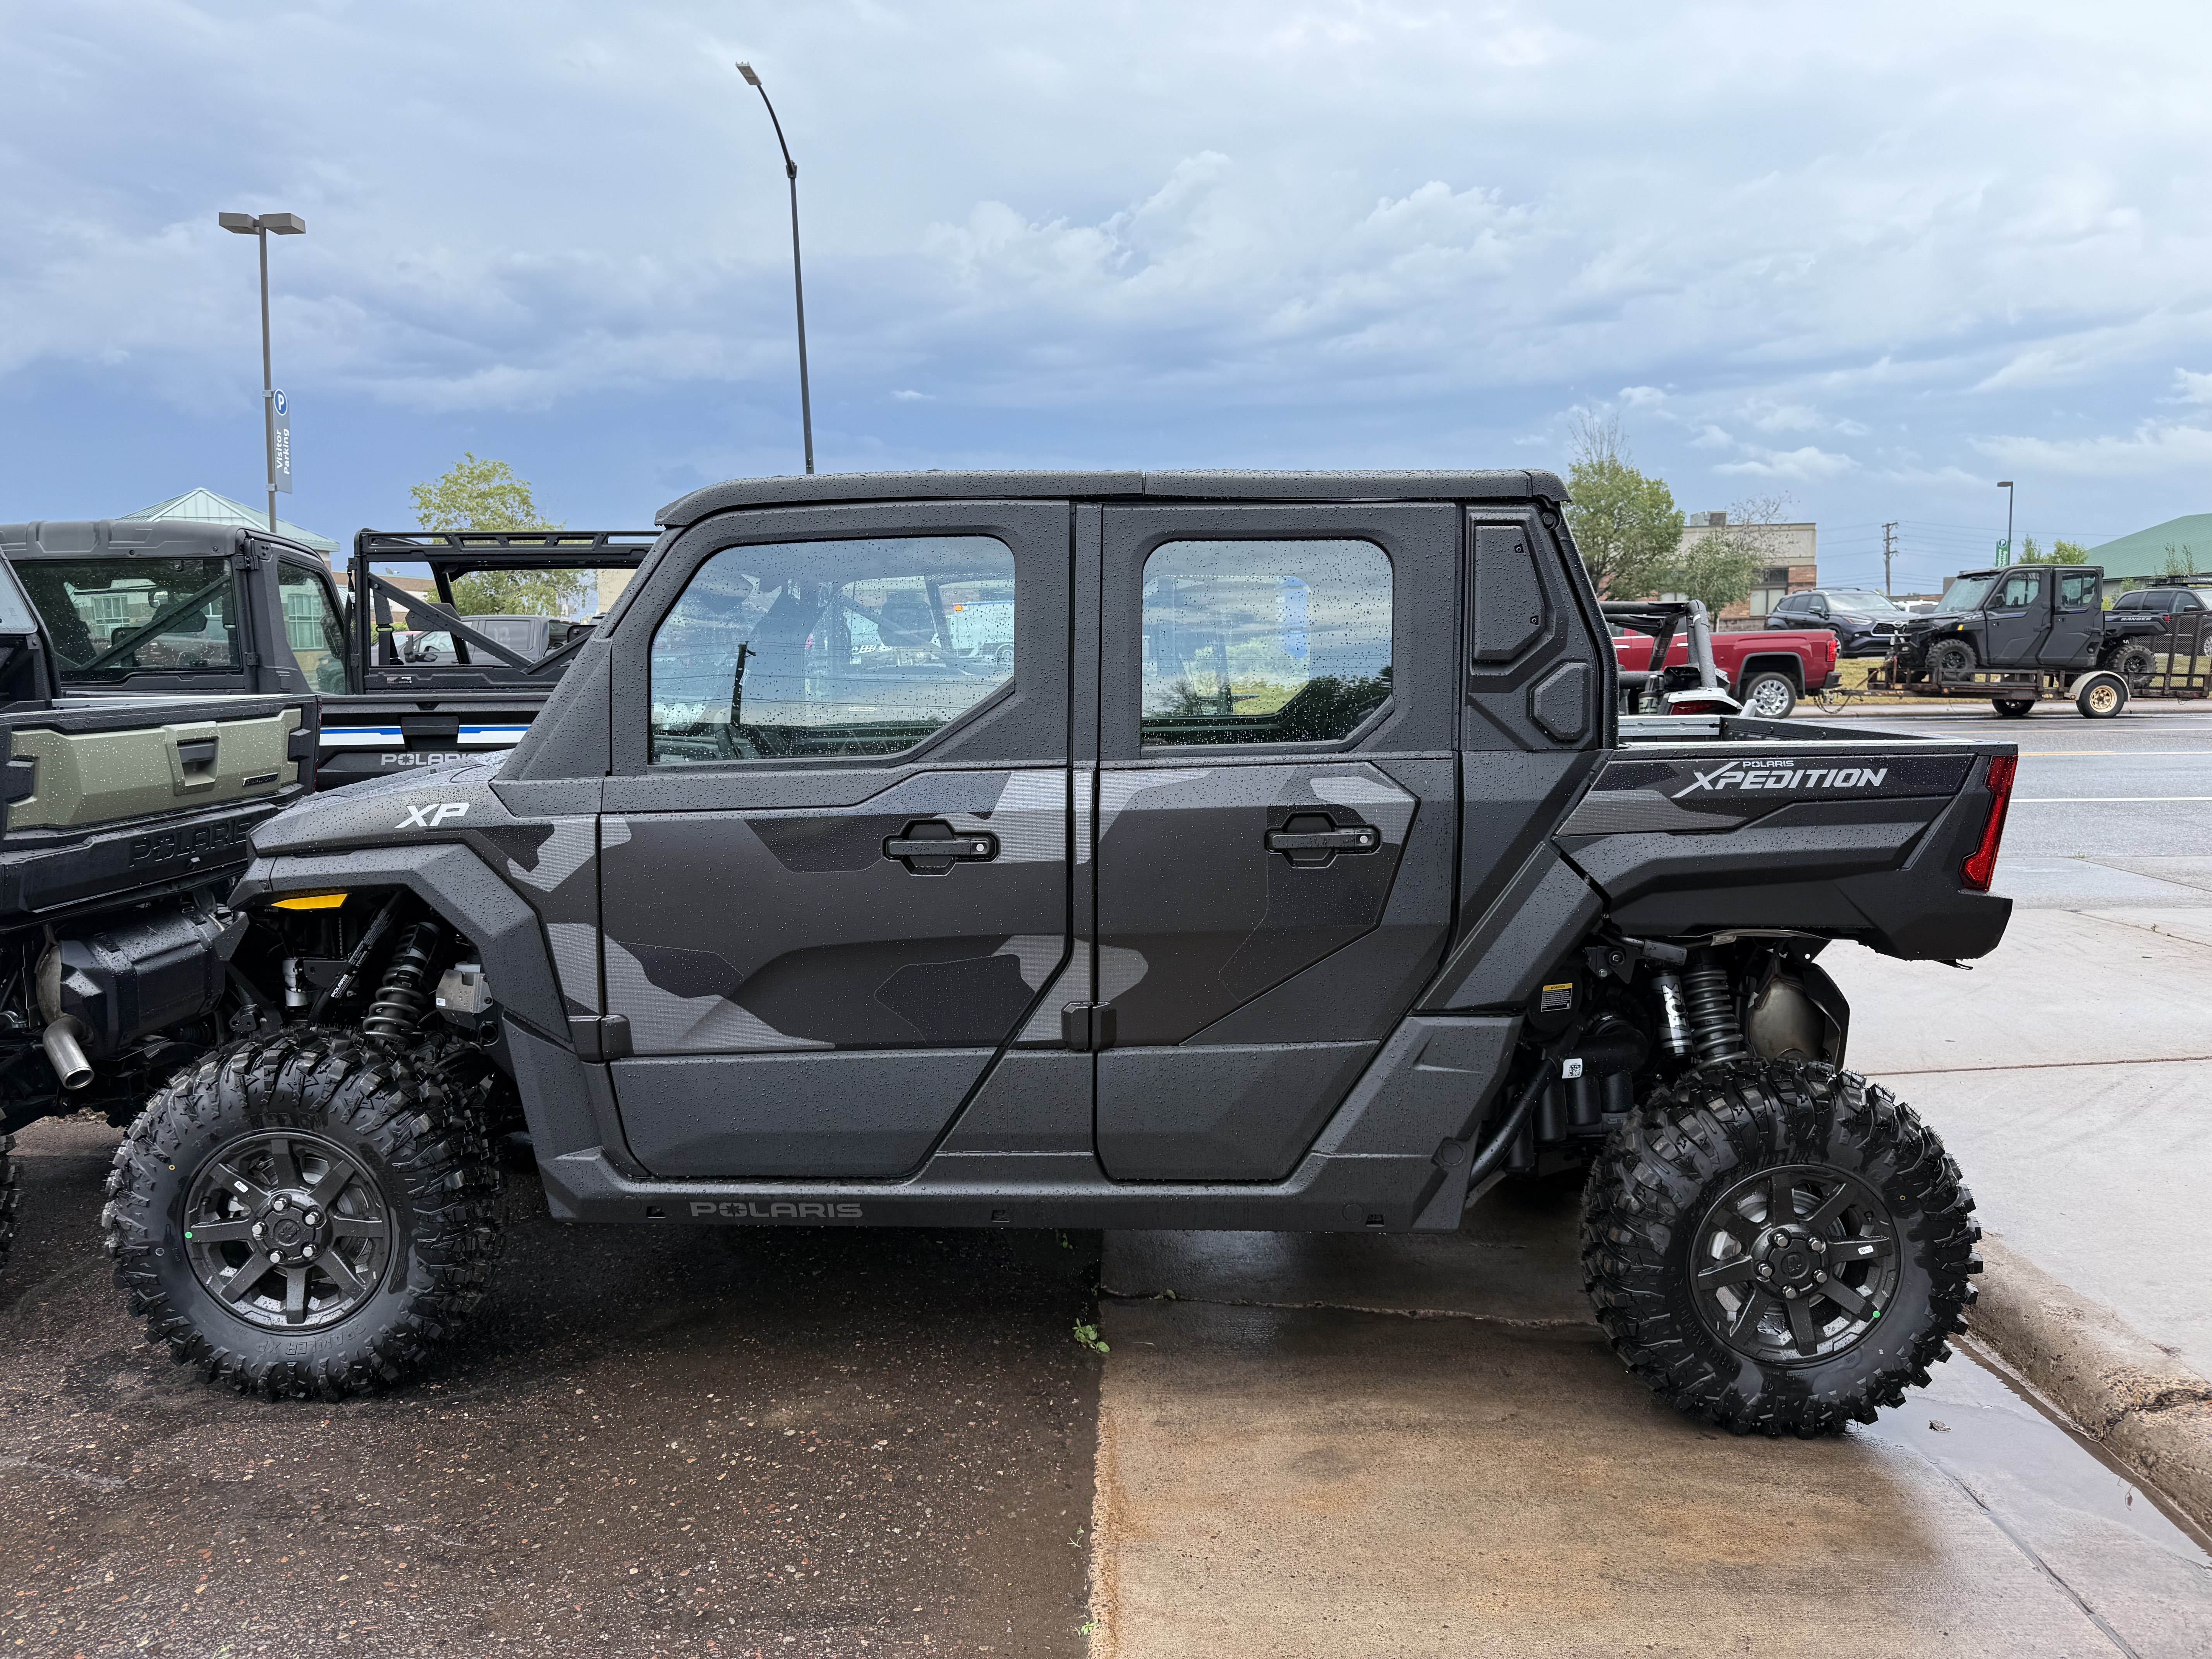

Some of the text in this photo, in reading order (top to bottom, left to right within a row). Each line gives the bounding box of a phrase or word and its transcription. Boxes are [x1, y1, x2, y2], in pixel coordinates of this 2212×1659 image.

[278, 393, 284, 410] P
[1670, 761, 1888, 798] XPEDITION
[394, 802, 470, 829] XP
[331, 974, 348, 998] POLARIS
[1661, 984, 1686, 1028] FOX
[690, 1202, 863, 1218] POLARIS
[285, 1324, 367, 1355] CRAWLER
